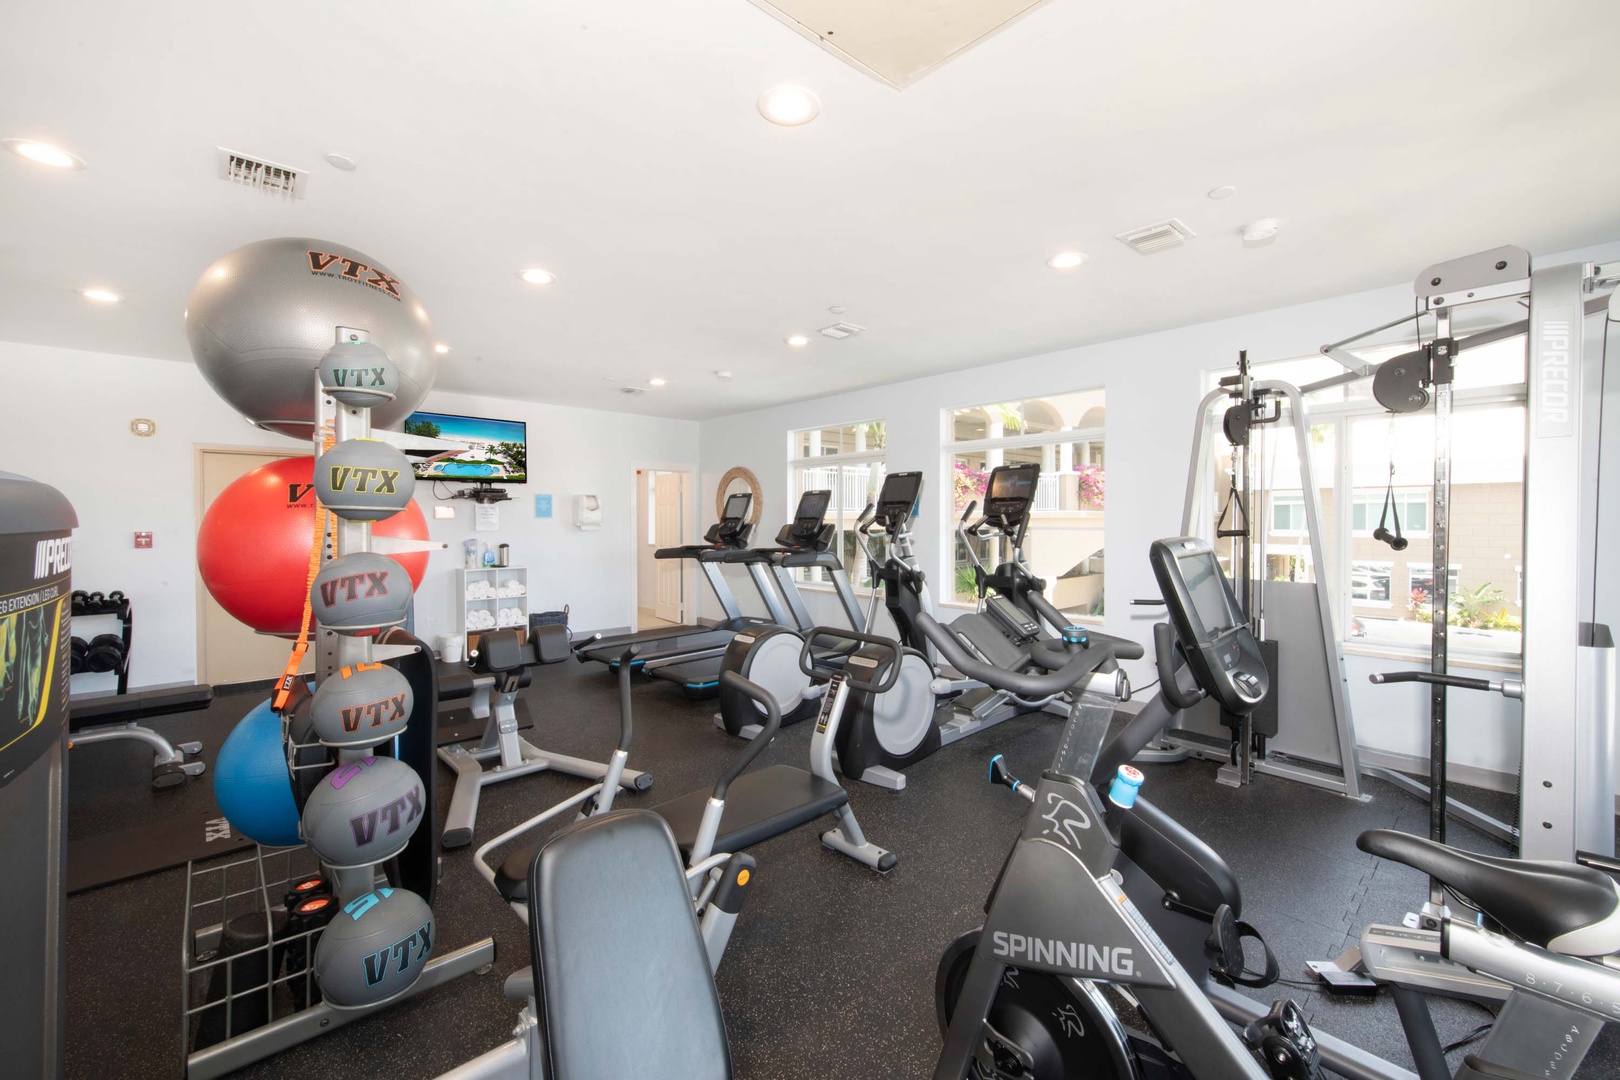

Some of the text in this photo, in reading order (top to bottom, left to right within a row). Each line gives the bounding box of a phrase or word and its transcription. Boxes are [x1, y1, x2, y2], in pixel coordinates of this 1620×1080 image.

[307, 250, 401, 297] VTX
[332, 367, 387, 388] VTX
[1542, 335, 1569, 423] PRECOR
[330, 466, 399, 494] VTX
[9, 592, 40, 611] EXTENSION
[320, 571, 389, 609] VTX
[341, 692, 406, 732] VTX
[349, 783, 422, 848] VTX
[362, 919, 431, 988] VTX
[993, 931, 1134, 976] SPINNING
